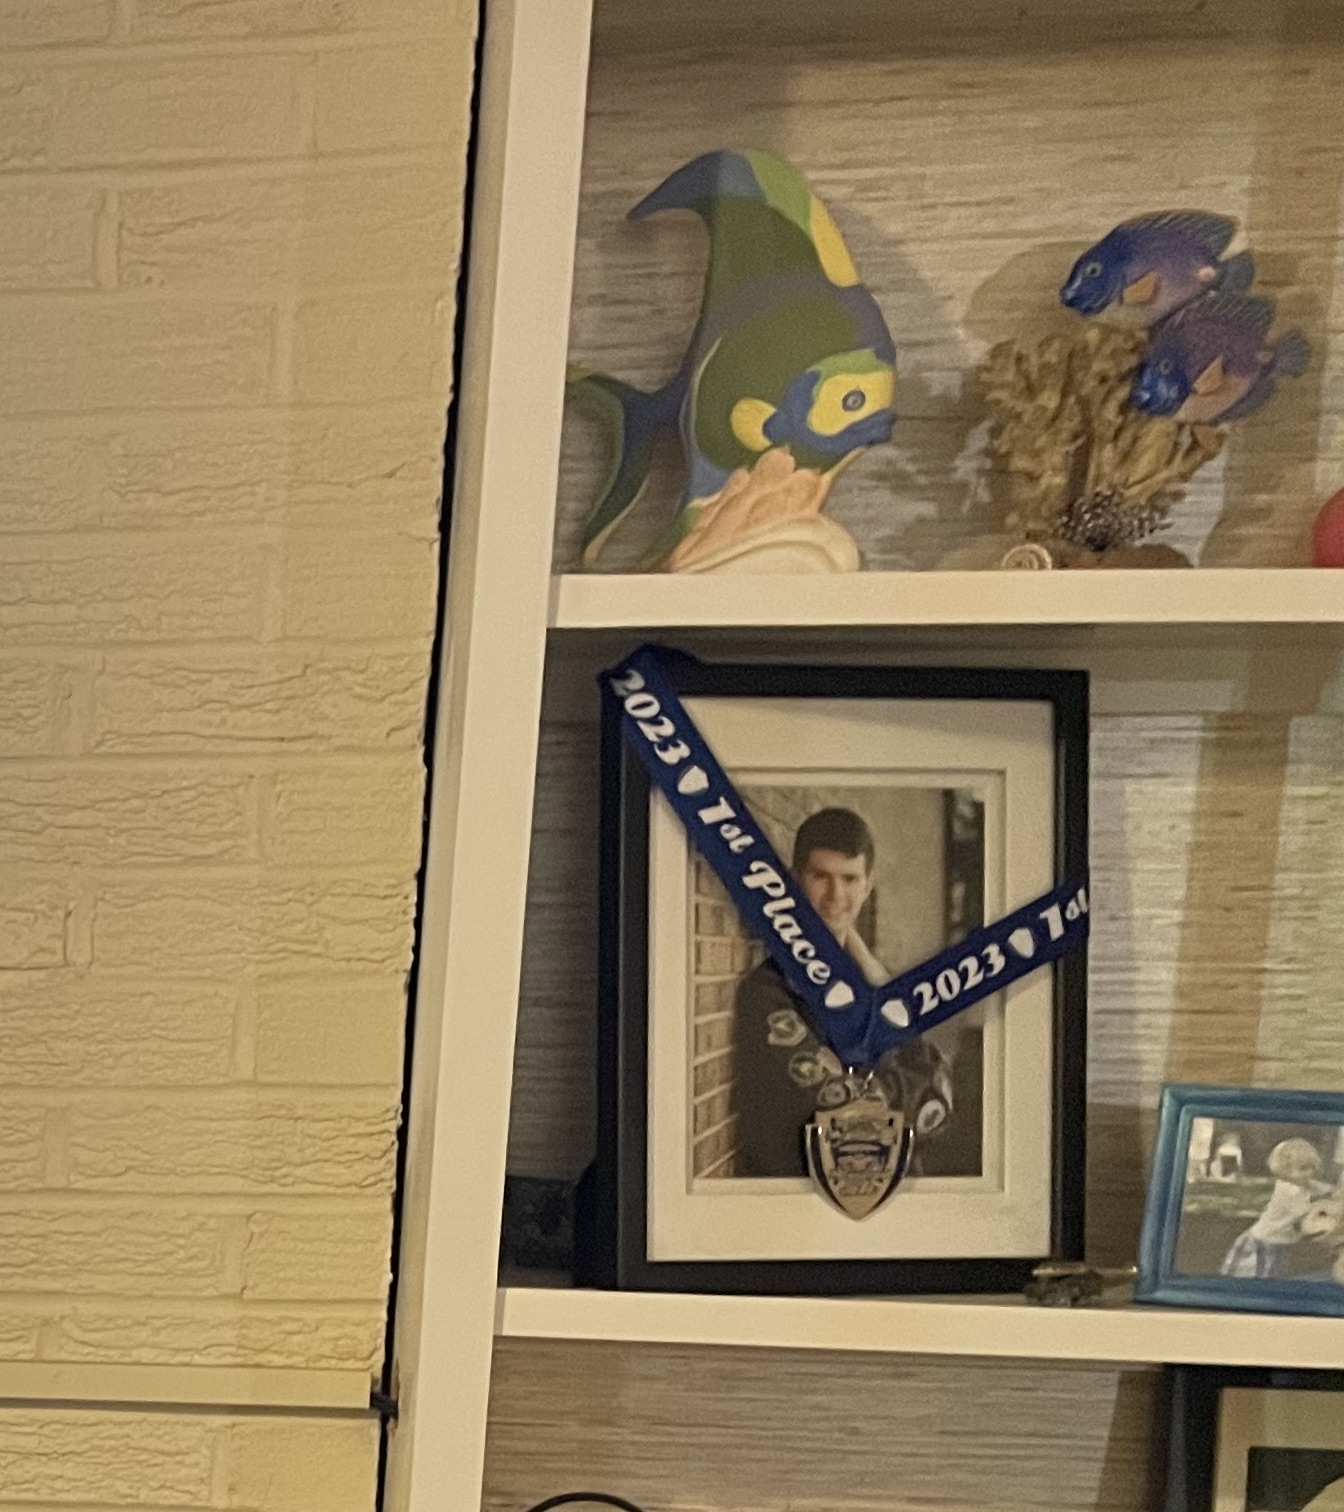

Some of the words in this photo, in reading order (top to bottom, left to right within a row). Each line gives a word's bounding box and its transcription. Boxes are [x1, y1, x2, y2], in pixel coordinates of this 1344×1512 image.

[609, 668, 691, 765] 2023
[697, 796, 755, 854] 1st
[742, 860, 831, 985] Place
[912, 942, 1006, 1016] 2023
